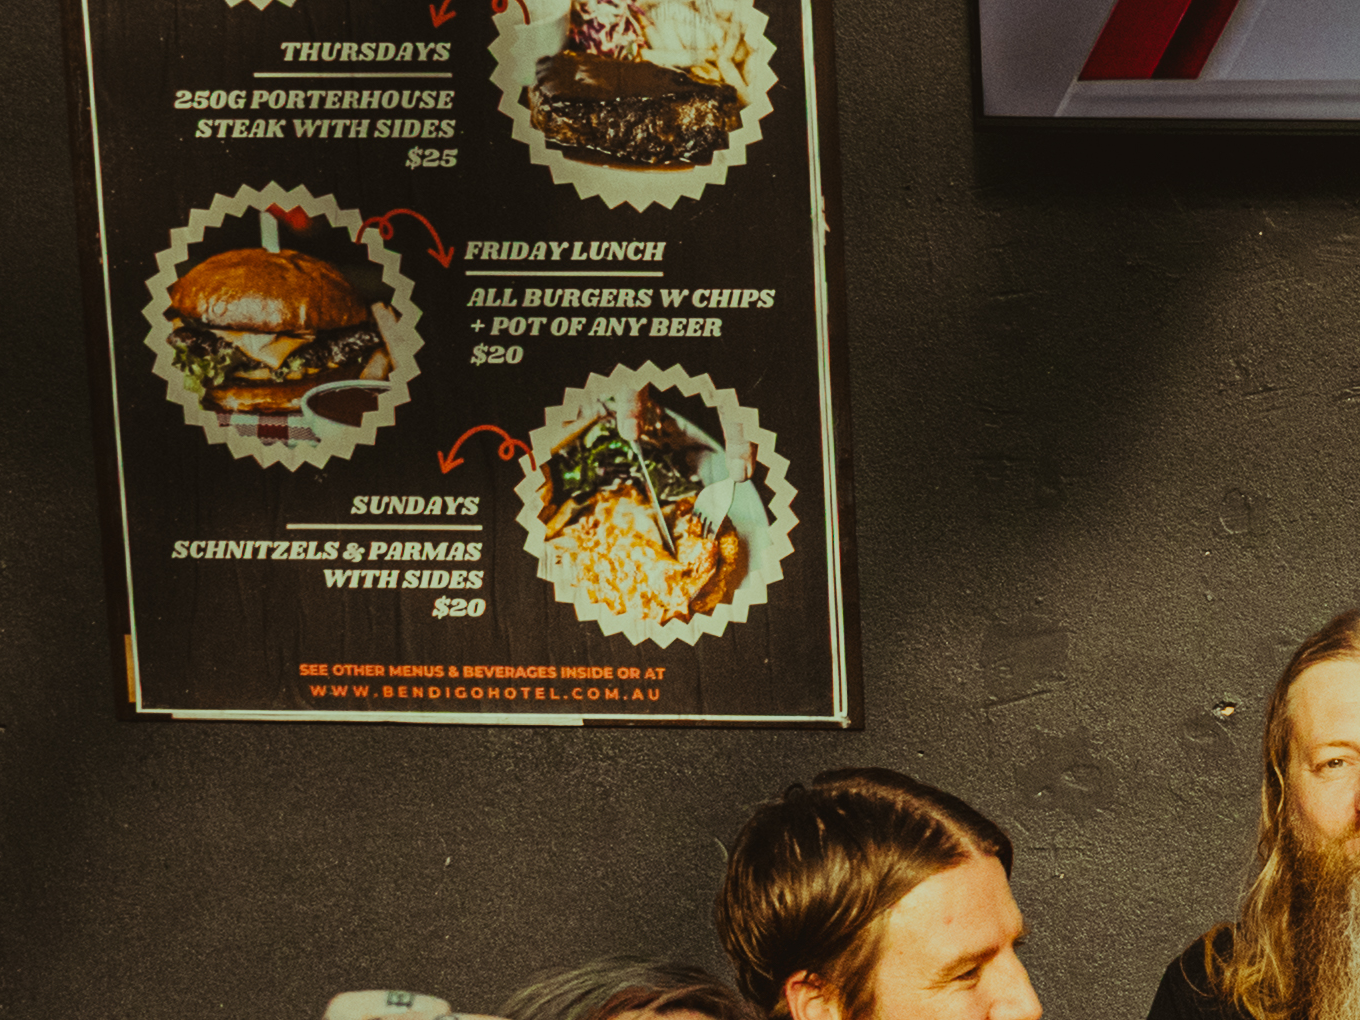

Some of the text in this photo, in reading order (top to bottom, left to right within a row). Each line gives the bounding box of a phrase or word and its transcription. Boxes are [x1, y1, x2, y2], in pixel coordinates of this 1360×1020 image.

[280, 42, 451, 61] THURSDAYS
[174, 90, 455, 109] 250G PORTERHOUSE
[195, 119, 456, 138] STEAK WITH SIDES
[405, 146, 458, 170] $25
[464, 241, 666, 261] FRIDAY LUNCH
[466, 288, 776, 308] ALL BURGERS W CHIPS
[490, 317, 547, 336] POT
[550, 317, 587, 336] OF
[588, 317, 647, 336] ANY
[649, 317, 723, 337] BEER
[470, 343, 524, 366] $20
[350, 495, 480, 515] SUNDAYS
[171, 540, 483, 563] SCHNITZELS & PARMAS
[323, 569, 484, 589] WITH SIDES
[431, 595, 487, 619] $20
[299, 664, 666, 680] SEE OTHER MENUS & BEVERAGES INSIDE OR AT
[309, 685, 660, 701] WWW.BENDIGOHOTEL.COM.AU
